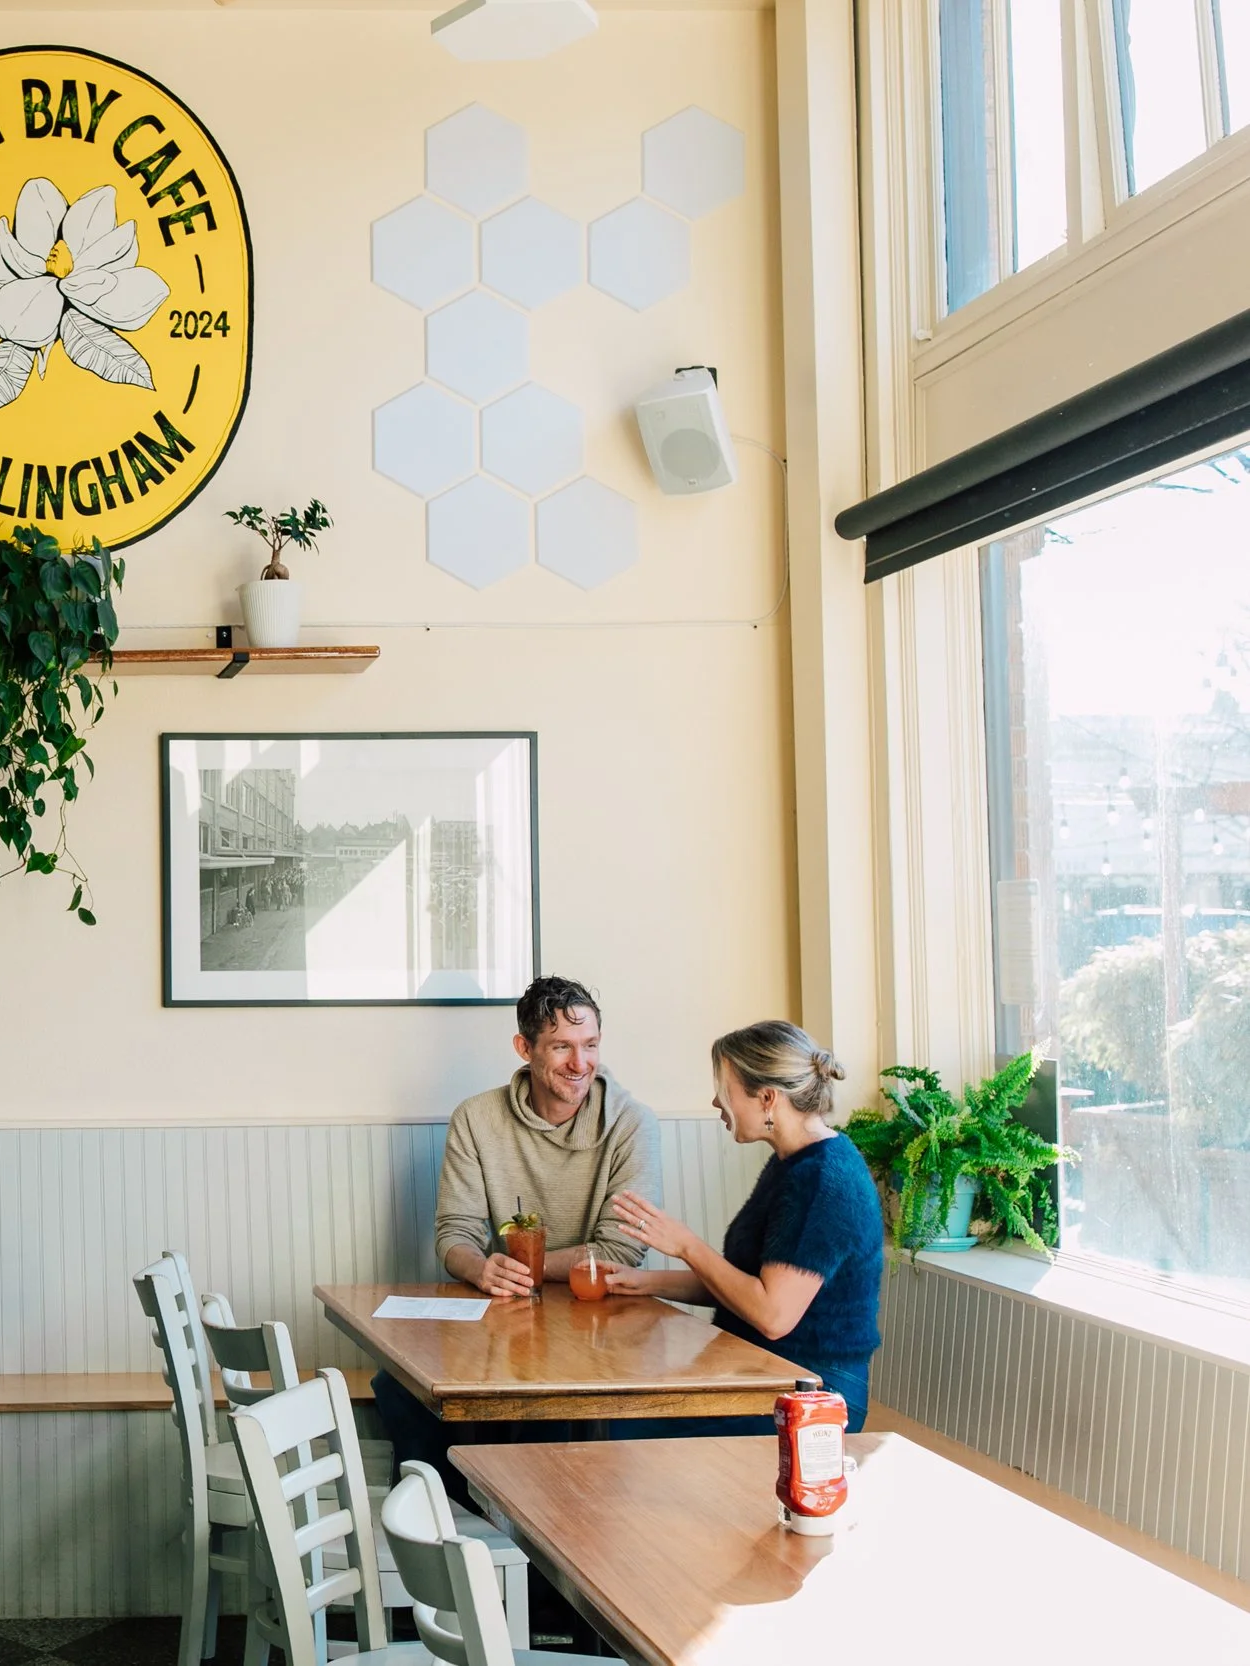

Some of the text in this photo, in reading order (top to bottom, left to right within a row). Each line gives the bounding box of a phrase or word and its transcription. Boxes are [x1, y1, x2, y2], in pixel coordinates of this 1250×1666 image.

[22, 79, 122, 143] BAY
[113, 115, 217, 246] CAFE
[170, 310, 230, 339] 2024
[812, 1430, 832, 1438] HEINZ
